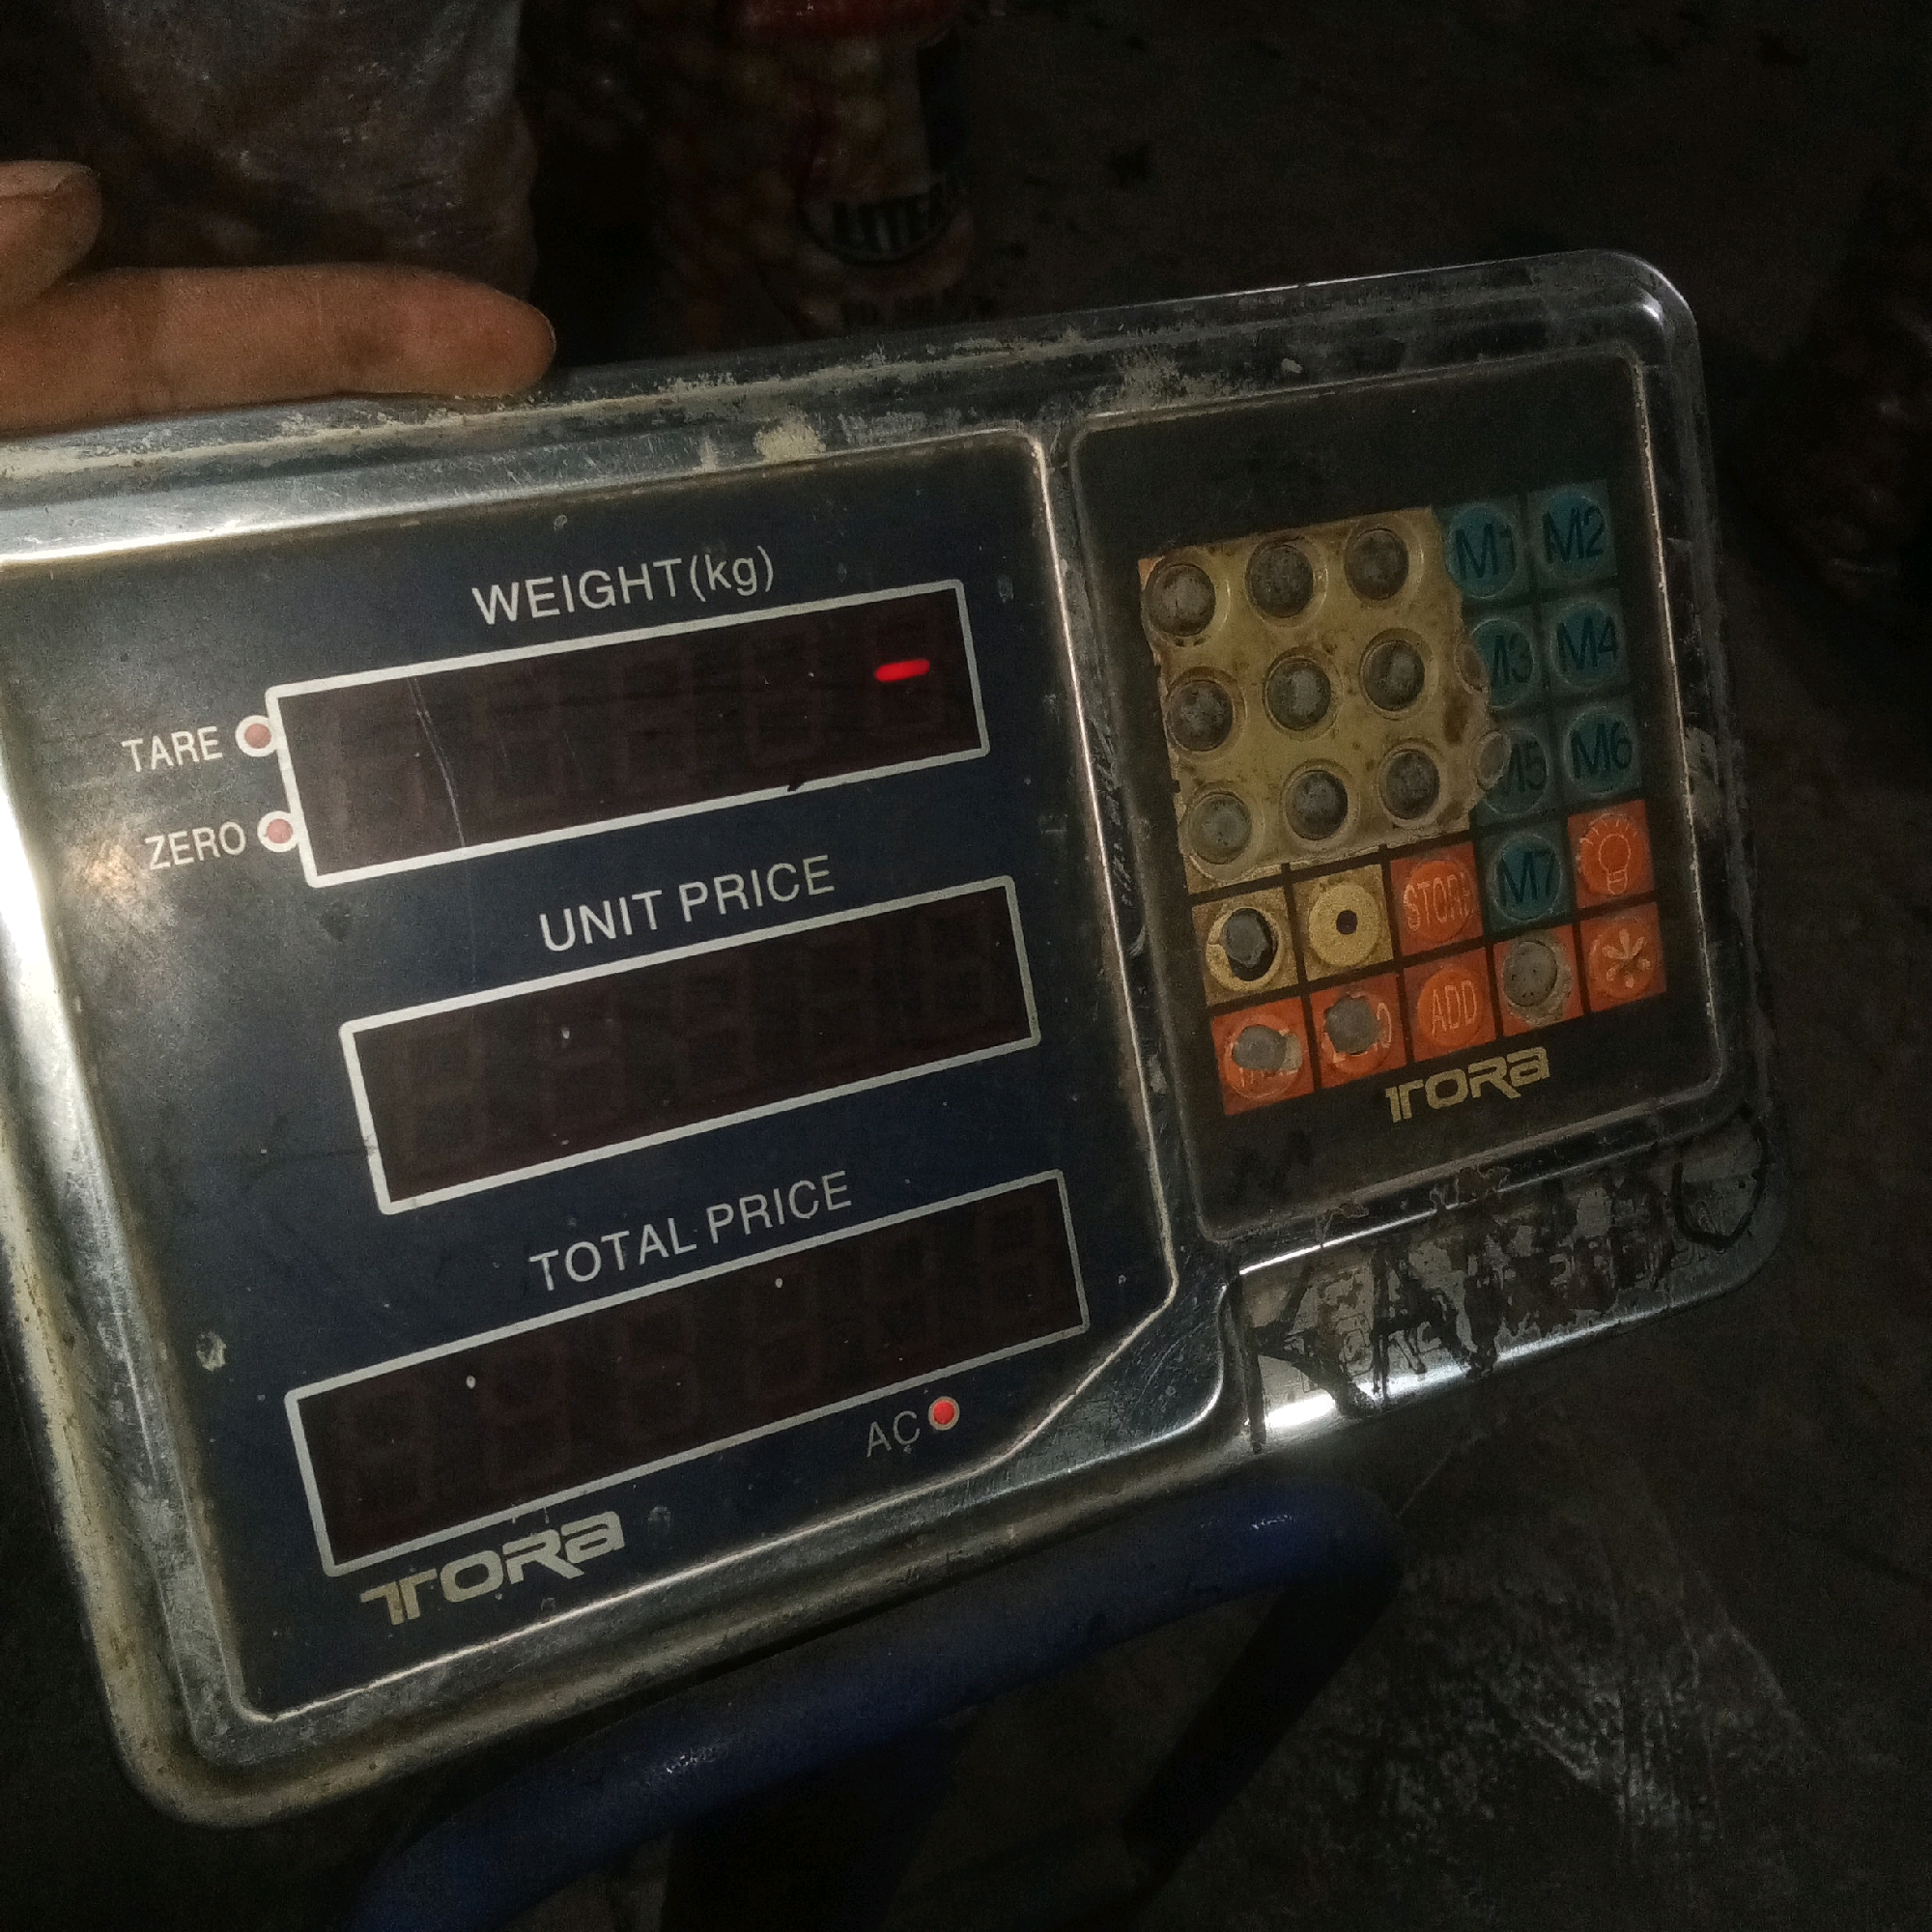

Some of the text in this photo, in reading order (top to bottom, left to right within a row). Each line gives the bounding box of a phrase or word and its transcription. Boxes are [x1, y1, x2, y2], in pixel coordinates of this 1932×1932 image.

[1454, 522, 1517, 580] M1
[1543, 506, 1605, 564] M2
[471, 546, 775, 625] WEIGHT(kg)
[1556, 615, 1618, 672] M4
[122, 725, 223, 773] TARE
[1569, 722, 1634, 779] M6
[144, 822, 246, 870] ZERO
[539, 854, 836, 953] UNIT PRICE
[1498, 850, 1557, 908] M7
[1431, 979, 1479, 1036] ADD
[528, 1170, 852, 1293] TOTAL PRICE
[866, 1409, 921, 1457] AC
